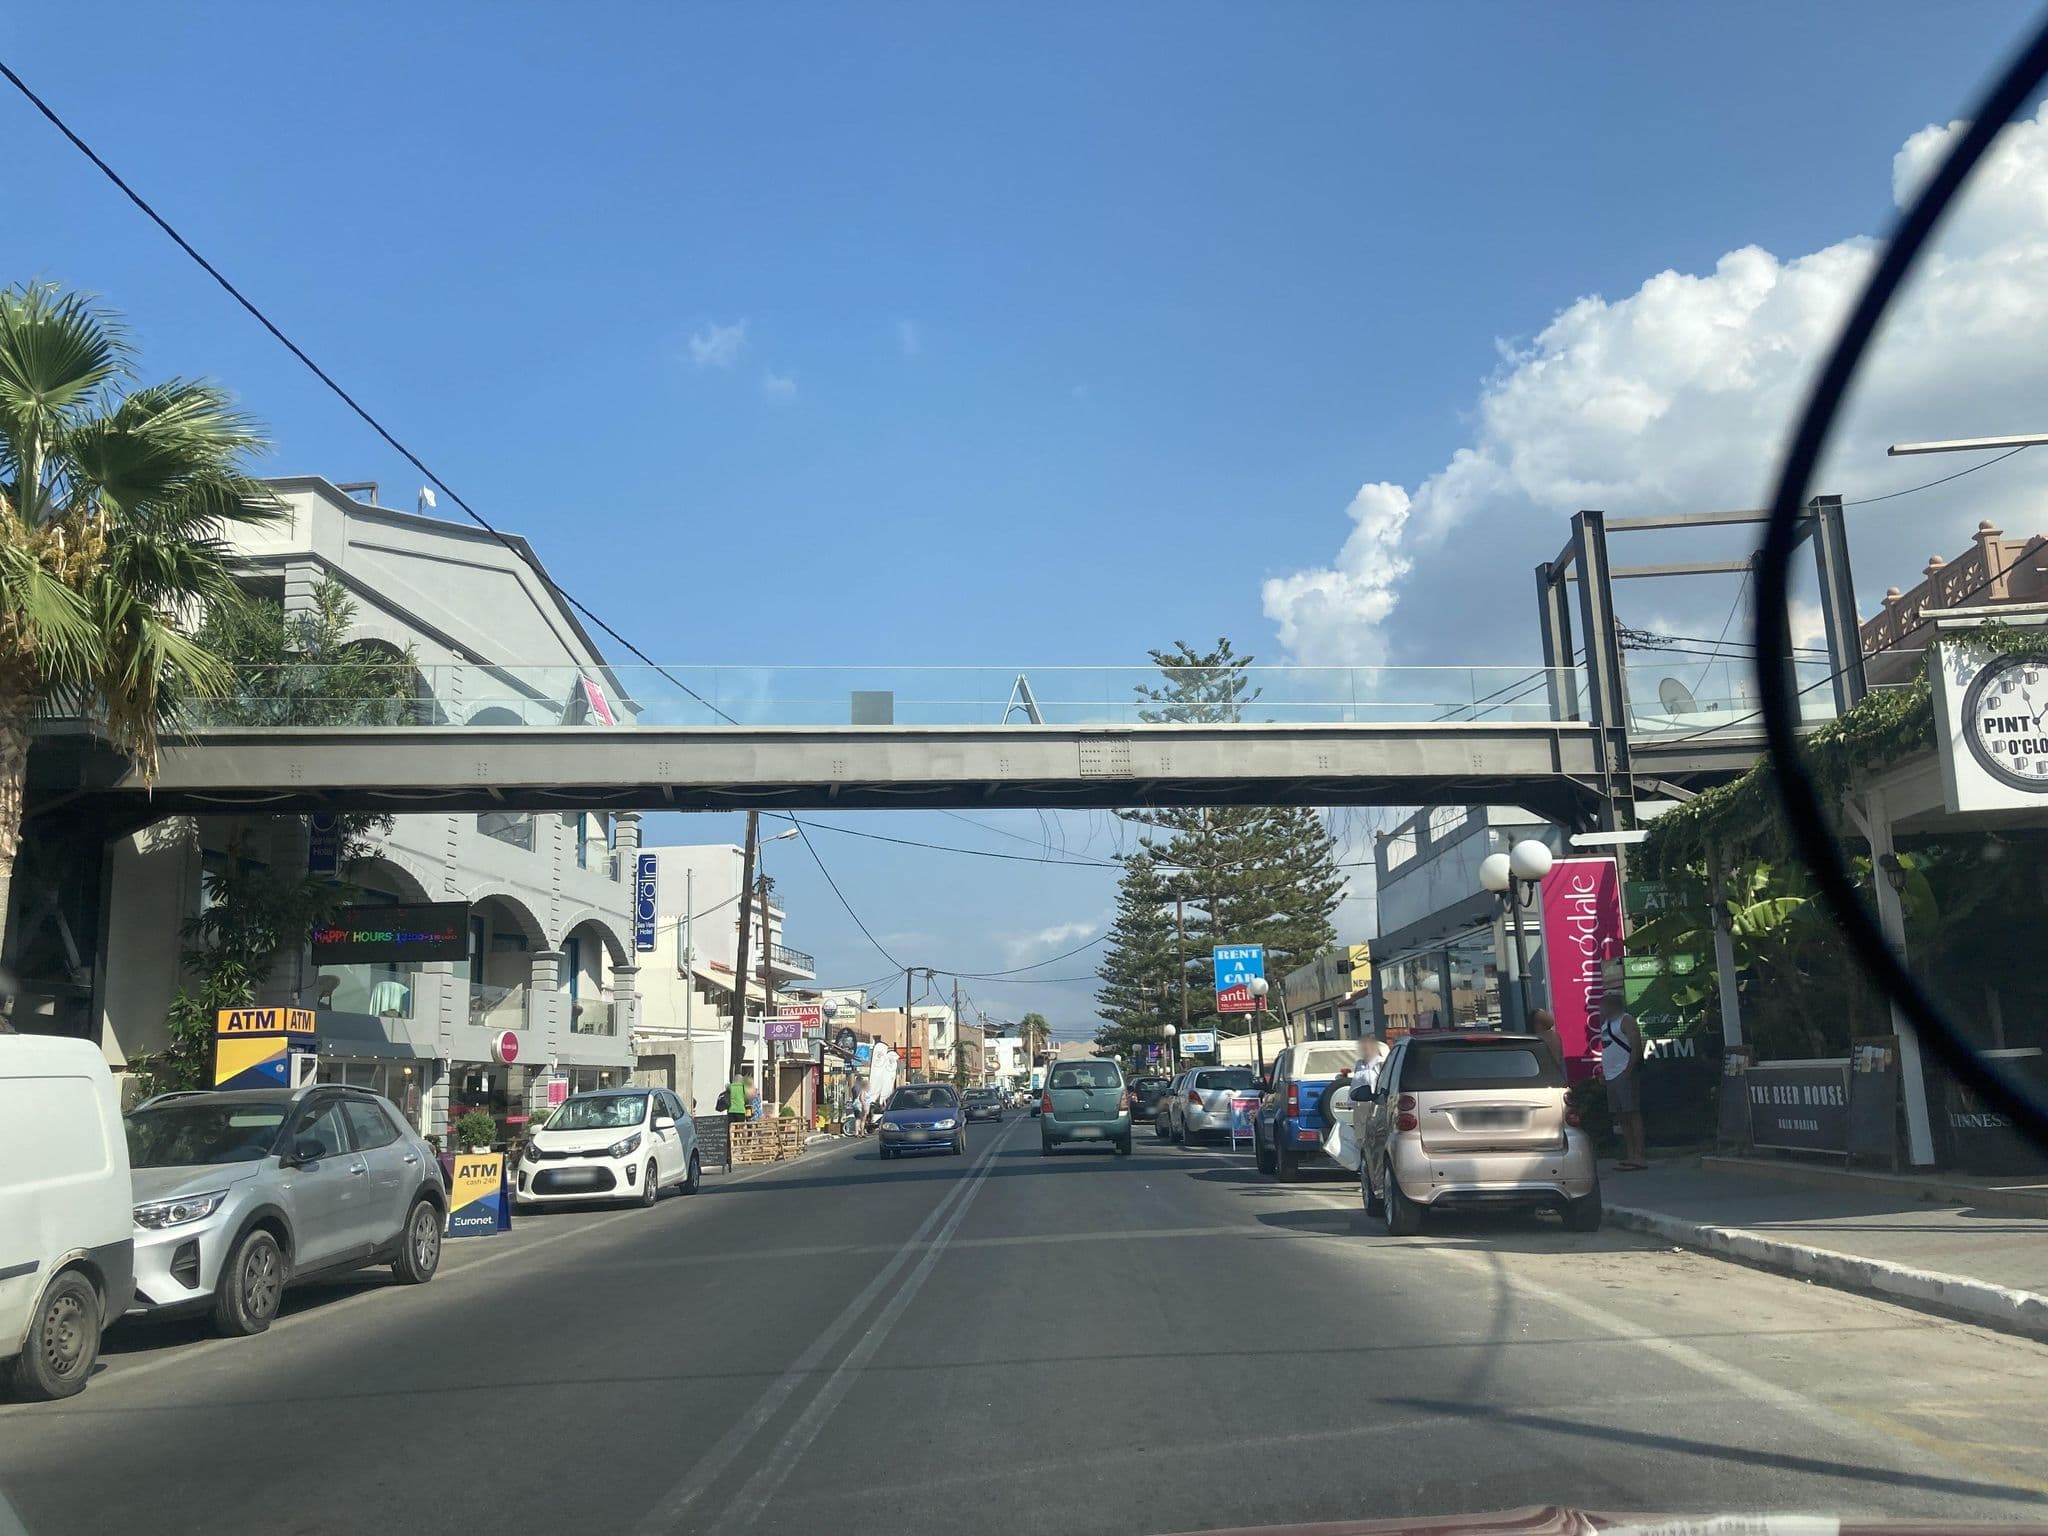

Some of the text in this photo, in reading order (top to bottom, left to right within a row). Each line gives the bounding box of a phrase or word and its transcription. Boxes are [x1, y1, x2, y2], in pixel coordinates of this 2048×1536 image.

[1984, 716, 2030, 734] PINT
[638, 857, 657, 920] Galini
[353, 931, 392, 943] HOURS
[1217, 949, 1260, 960] RENT
[1234, 961, 1245, 971] A
[781, 1006, 819, 1016] ITALIANA
[227, 1010, 276, 1031] ATM
[290, 1010, 312, 1031] ATM
[1643, 1037, 1695, 1060] ATM
[1750, 1085, 1844, 1106] THE BEER HOUSE
[459, 1163, 498, 1179] ATM
[466, 1178, 482, 1186] cash
